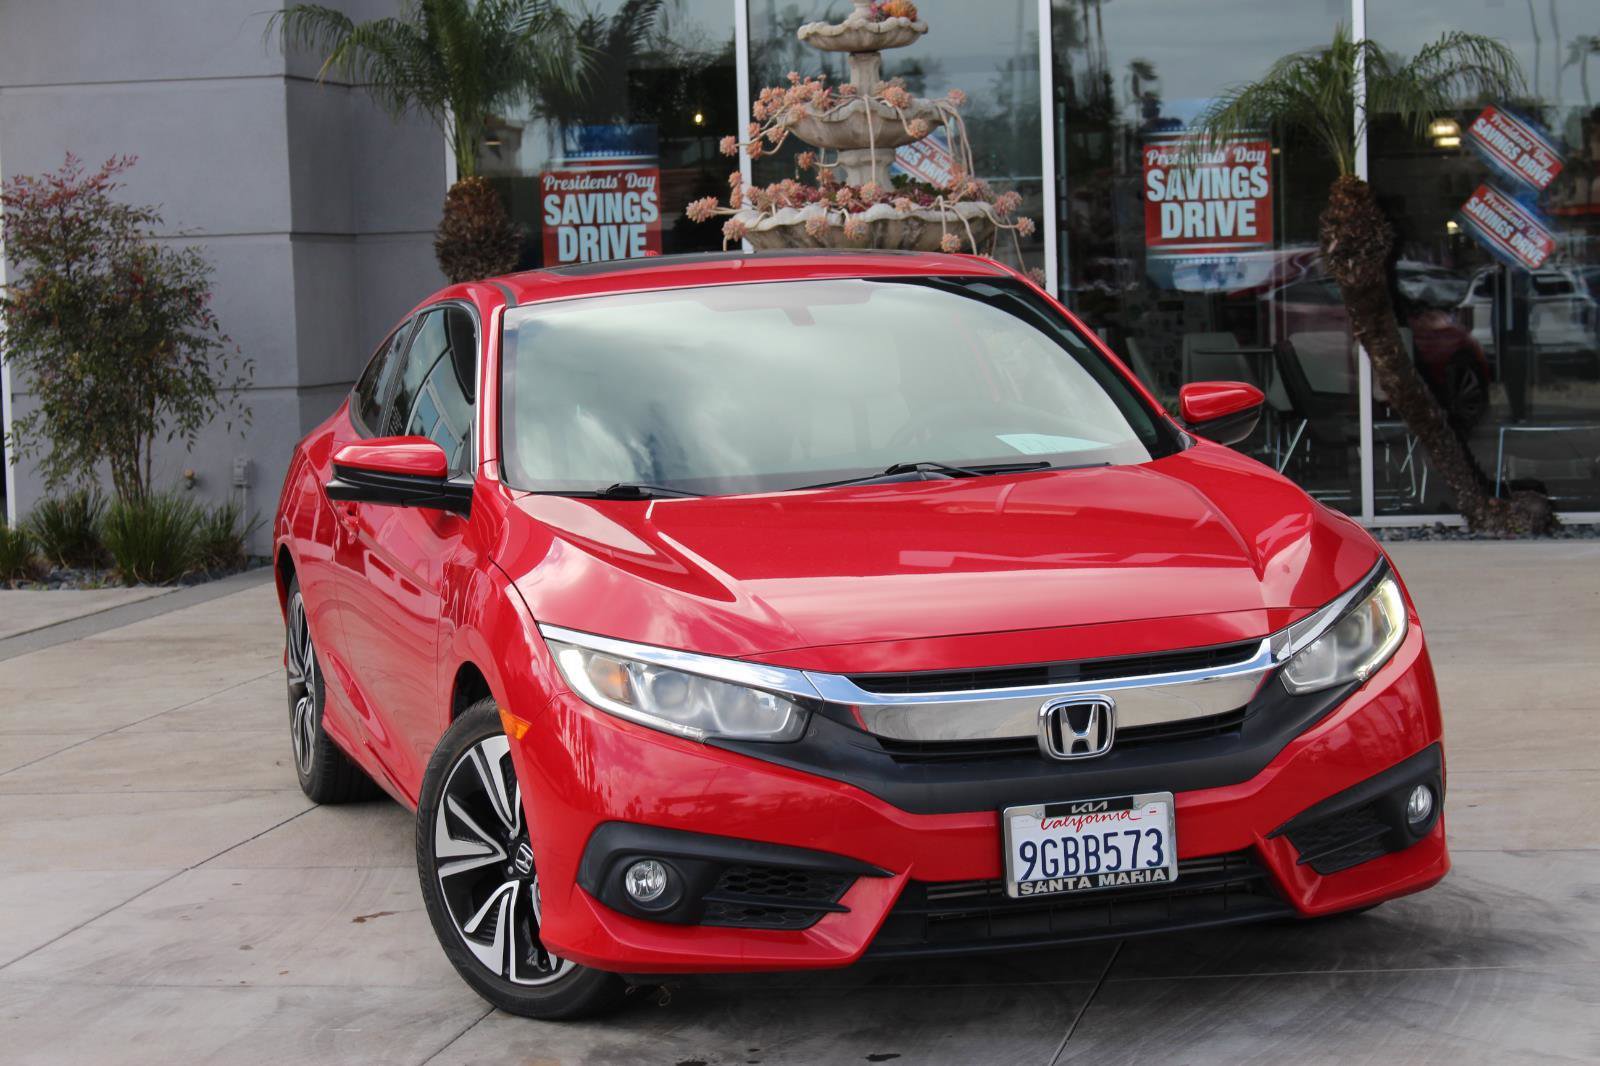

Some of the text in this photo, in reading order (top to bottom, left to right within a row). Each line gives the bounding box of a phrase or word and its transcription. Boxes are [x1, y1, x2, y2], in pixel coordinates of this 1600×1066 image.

[1233, 146, 1266, 166] Day
[1473, 118, 1553, 186] SAVINGS DRIVE
[1532, 149, 1553, 169] Day
[543, 172, 656, 191] Presidents' Day
[918, 157, 953, 188] DRIVE
[1146, 165, 1269, 201] SAVINGS
[543, 191, 659, 226] SAVINGS
[1161, 200, 1257, 239] DRIVE
[557, 223, 647, 263] DRIVE
[1466, 196, 1546, 265] SAVINGS DRIVE
[1526, 227, 1547, 247] Day
[1019, 827, 1164, 881] 9GBB573
[1020, 868, 1167, 895] SANTA MARIA
